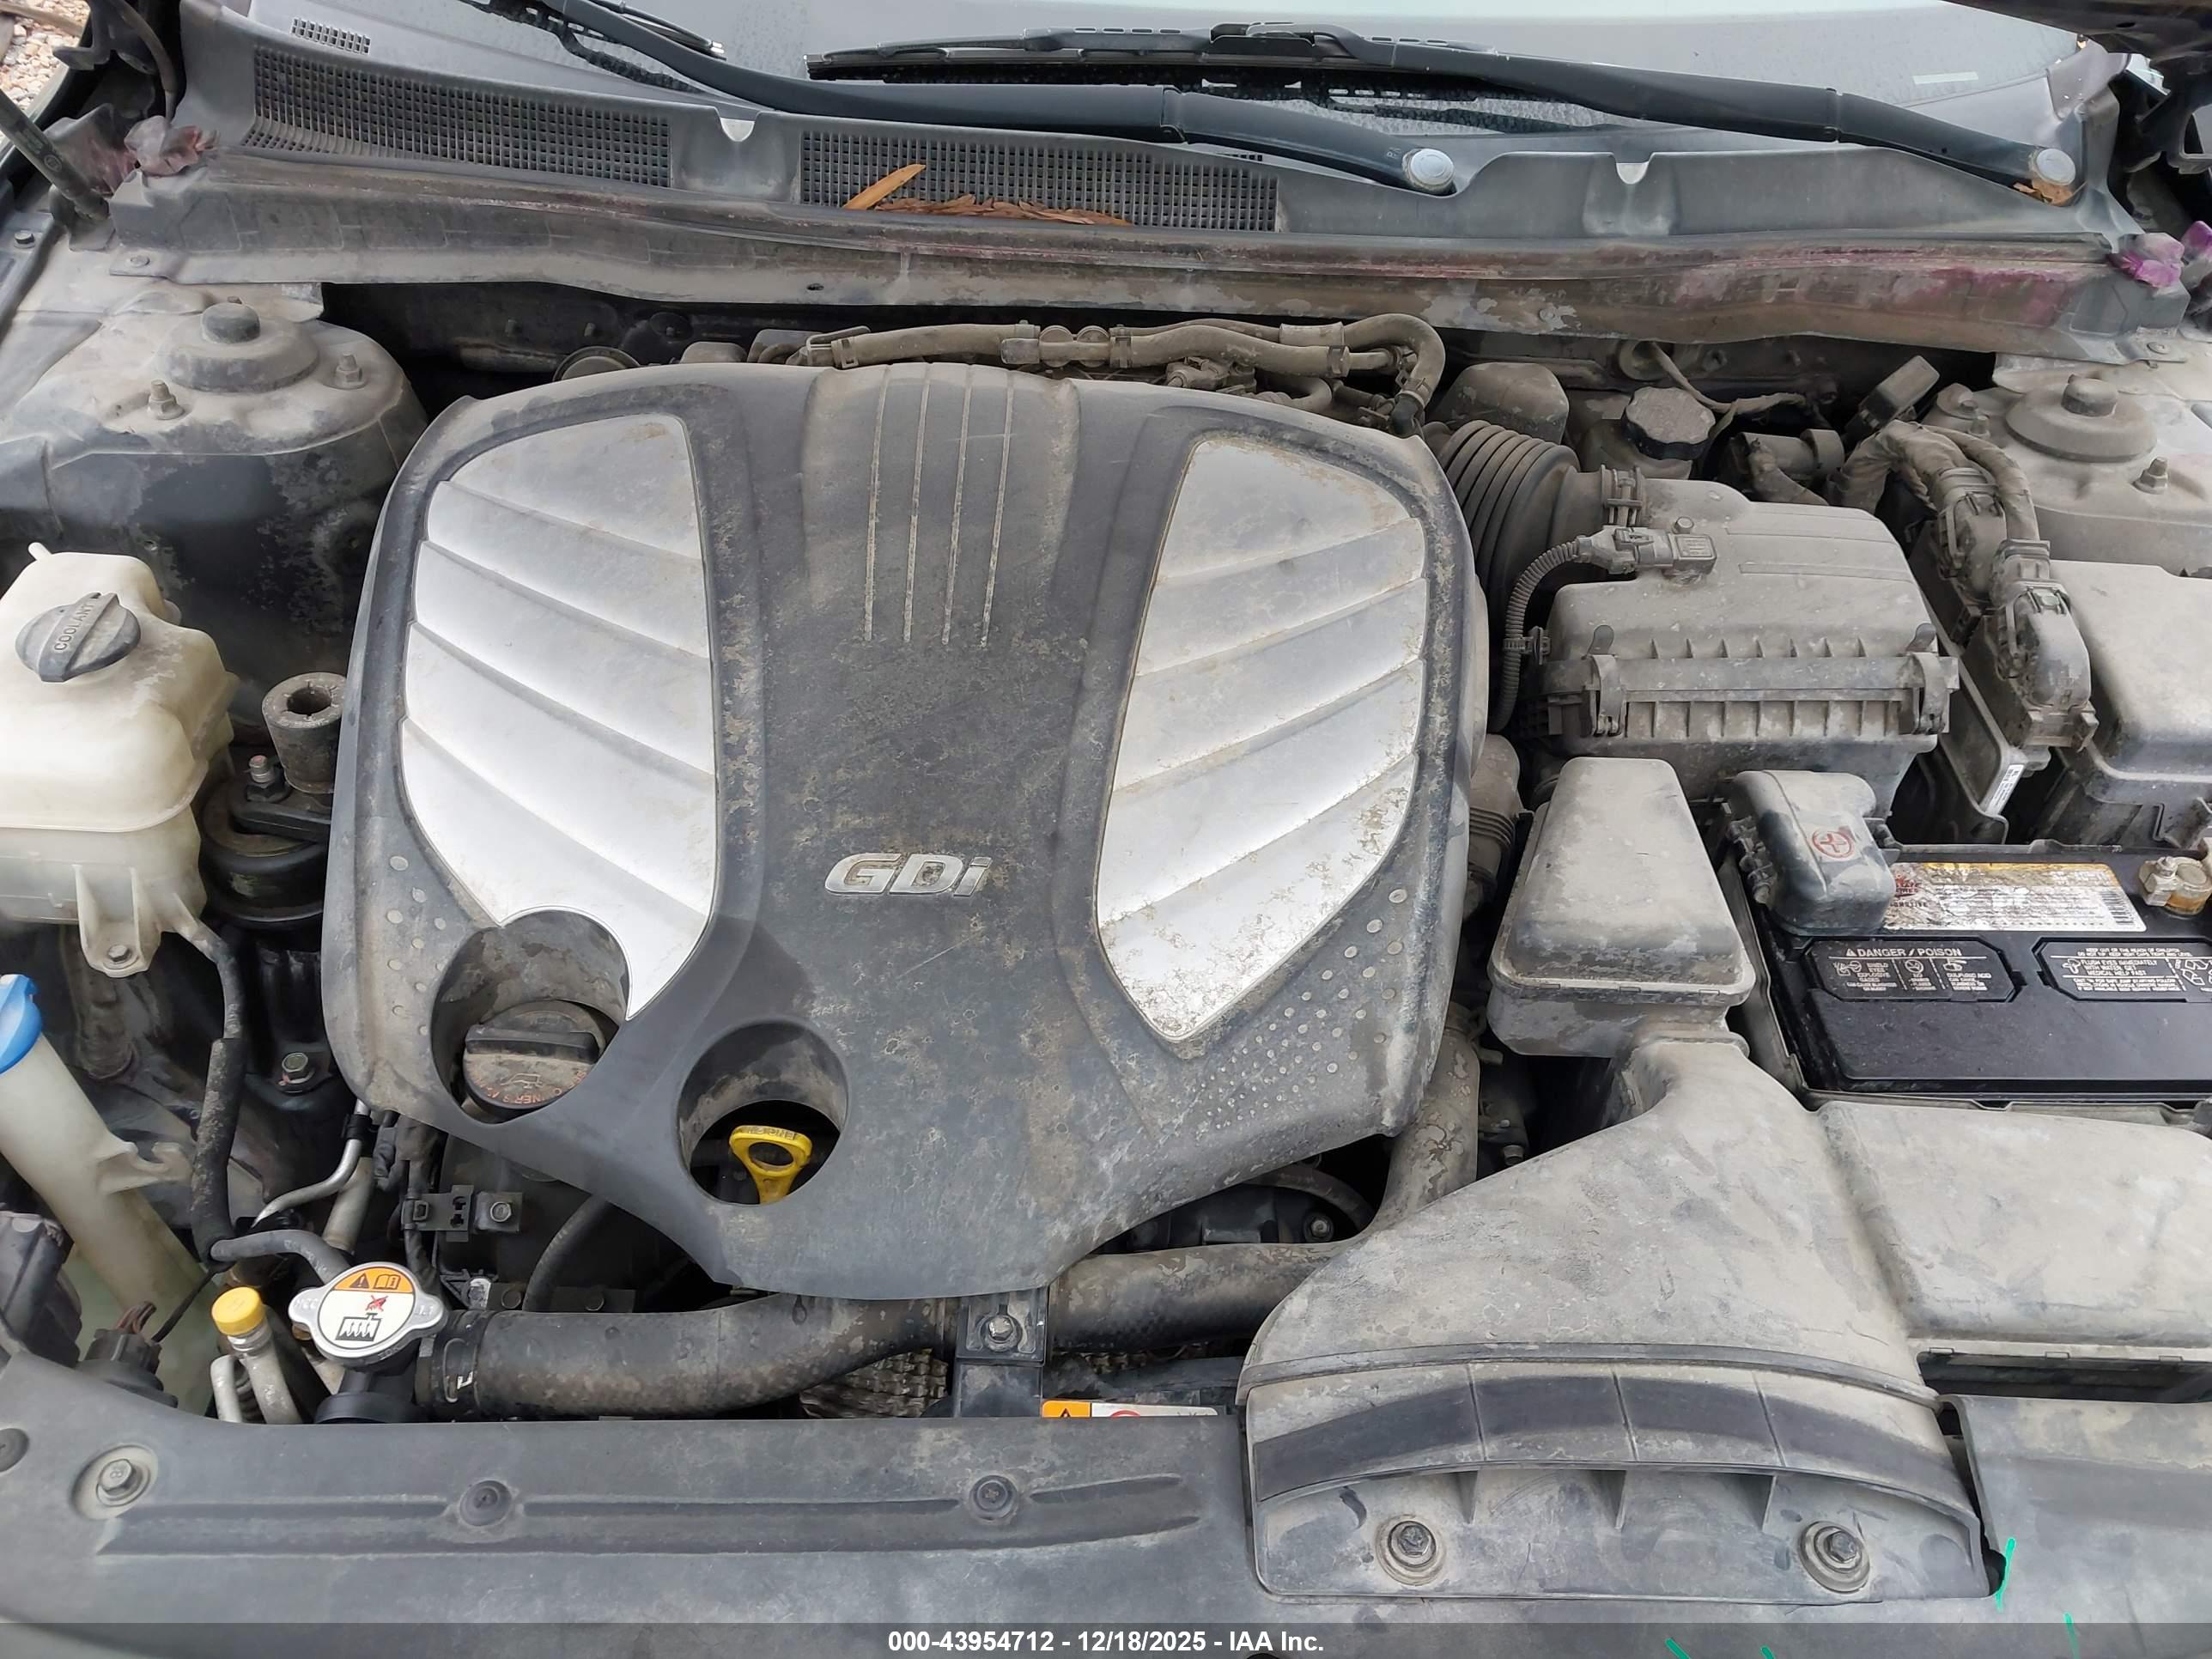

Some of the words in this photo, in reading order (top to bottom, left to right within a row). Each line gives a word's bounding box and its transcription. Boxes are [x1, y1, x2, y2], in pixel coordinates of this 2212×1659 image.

[53, 604, 94, 651] COOLANT
[824, 852, 992, 898] GDi
[1856, 948, 1906, 957] DANGER
[1917, 947, 1963, 957] POISON
